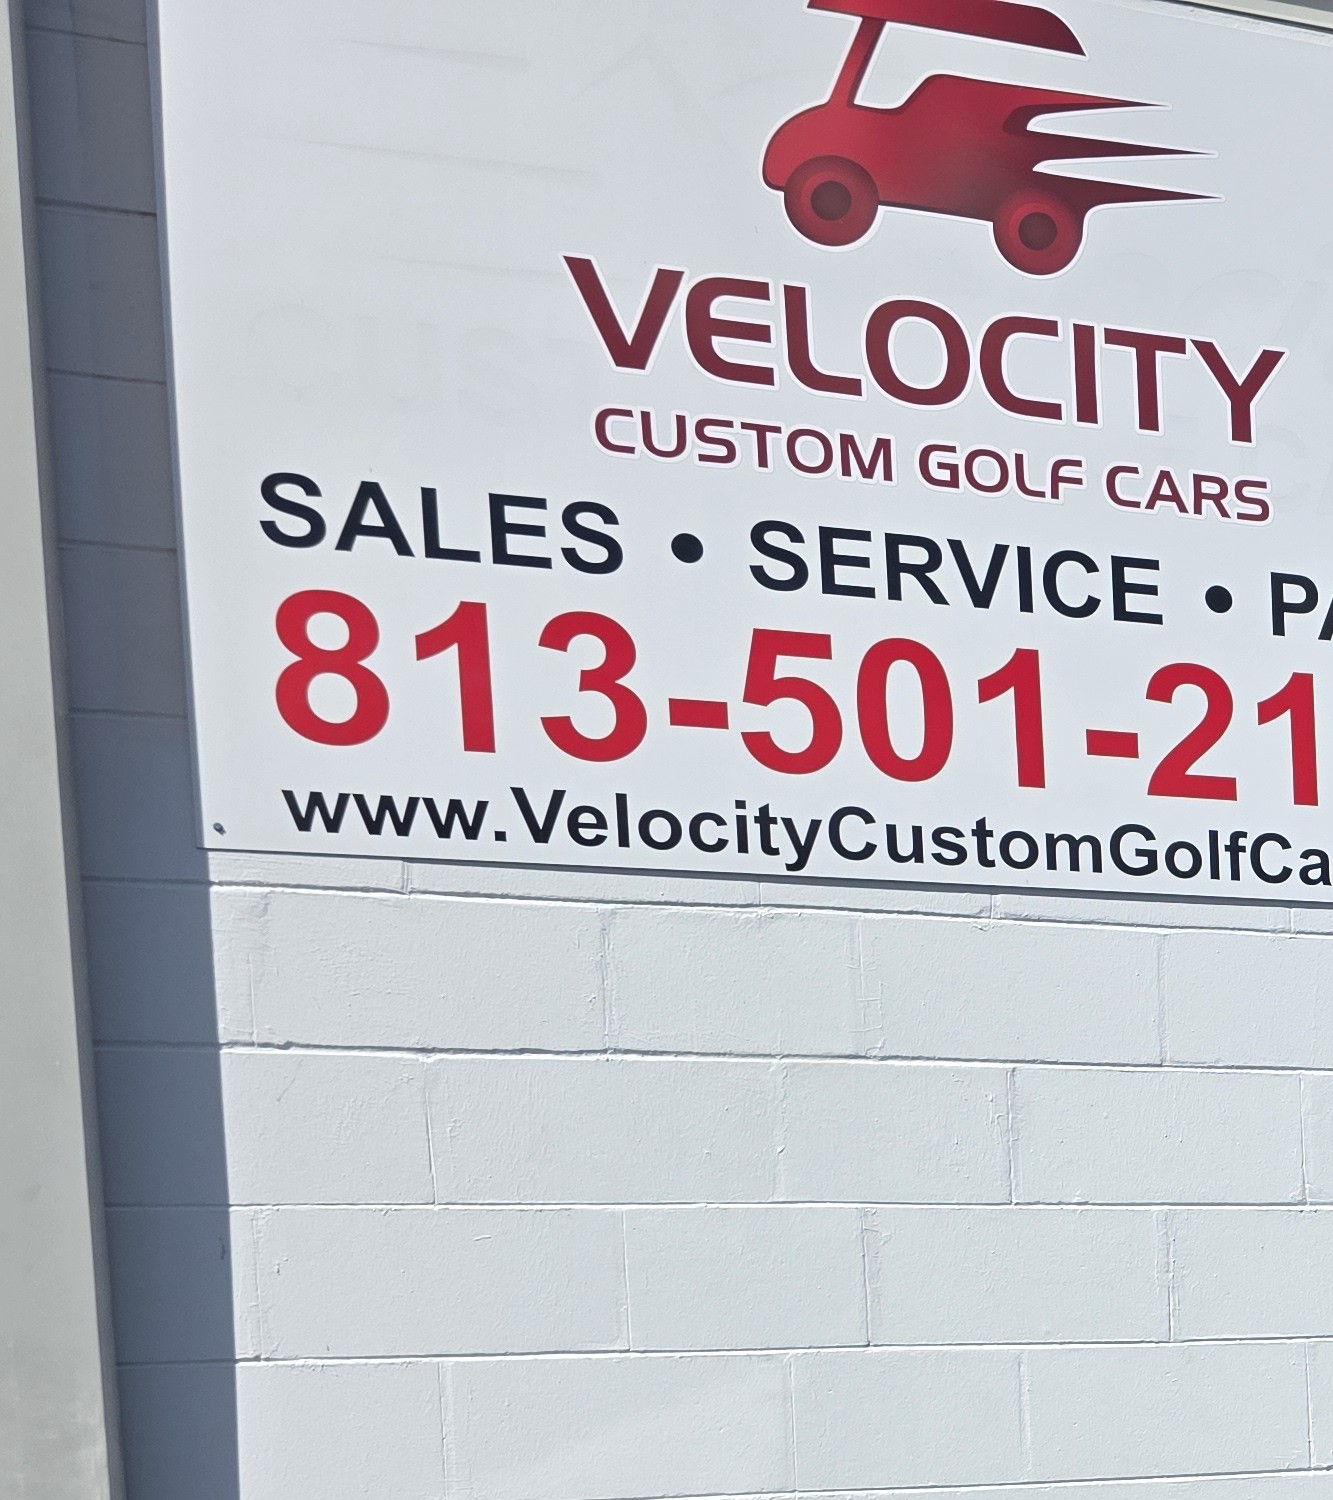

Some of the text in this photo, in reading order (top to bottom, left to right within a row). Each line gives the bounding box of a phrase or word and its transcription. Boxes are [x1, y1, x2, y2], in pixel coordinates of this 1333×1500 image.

[562, 255, 1286, 444] VELOCITY
[594, 407, 1271, 523] CUSTOM GOLF CARS
[259, 472, 625, 575] SALES
[749, 519, 1165, 627] SERVICE
